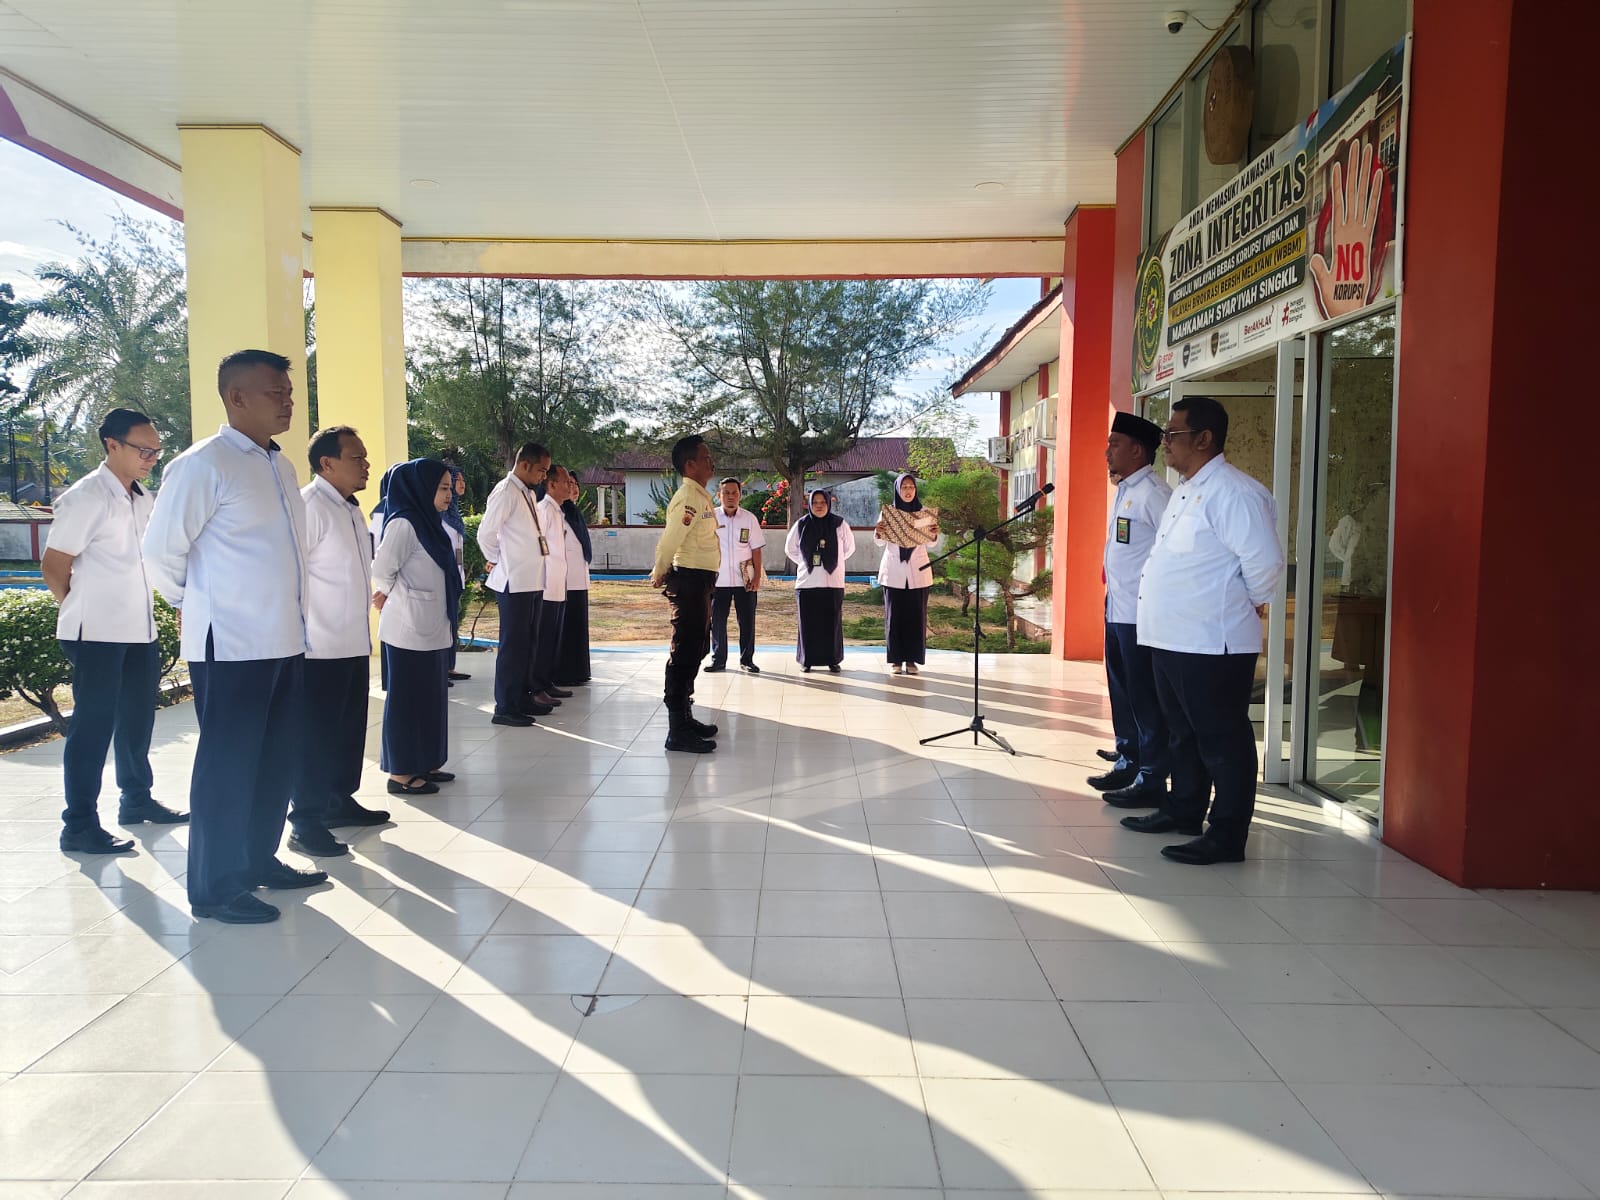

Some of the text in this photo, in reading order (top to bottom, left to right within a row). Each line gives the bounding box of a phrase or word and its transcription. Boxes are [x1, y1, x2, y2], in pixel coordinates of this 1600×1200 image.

[1170, 152, 1306, 284] ZONA INTEGRITAS
[1188, 149, 1275, 231] ANDA MEMASUKI KAWASAN
[1173, 214, 1299, 303] MENUJU WILAYAH BEBAS KORUPSI (WBK) DAN
[1220, 273, 1240, 293] BERSIH
[1241, 253, 1272, 281] MELAYANI
[1273, 236, 1302, 266] (WBBM)
[1334, 283, 1364, 301] KORUPSI
[1336, 241, 1364, 281] NO
[1172, 265, 1298, 341] MAHKAMAH SYAR'IYAH SINGKIL
